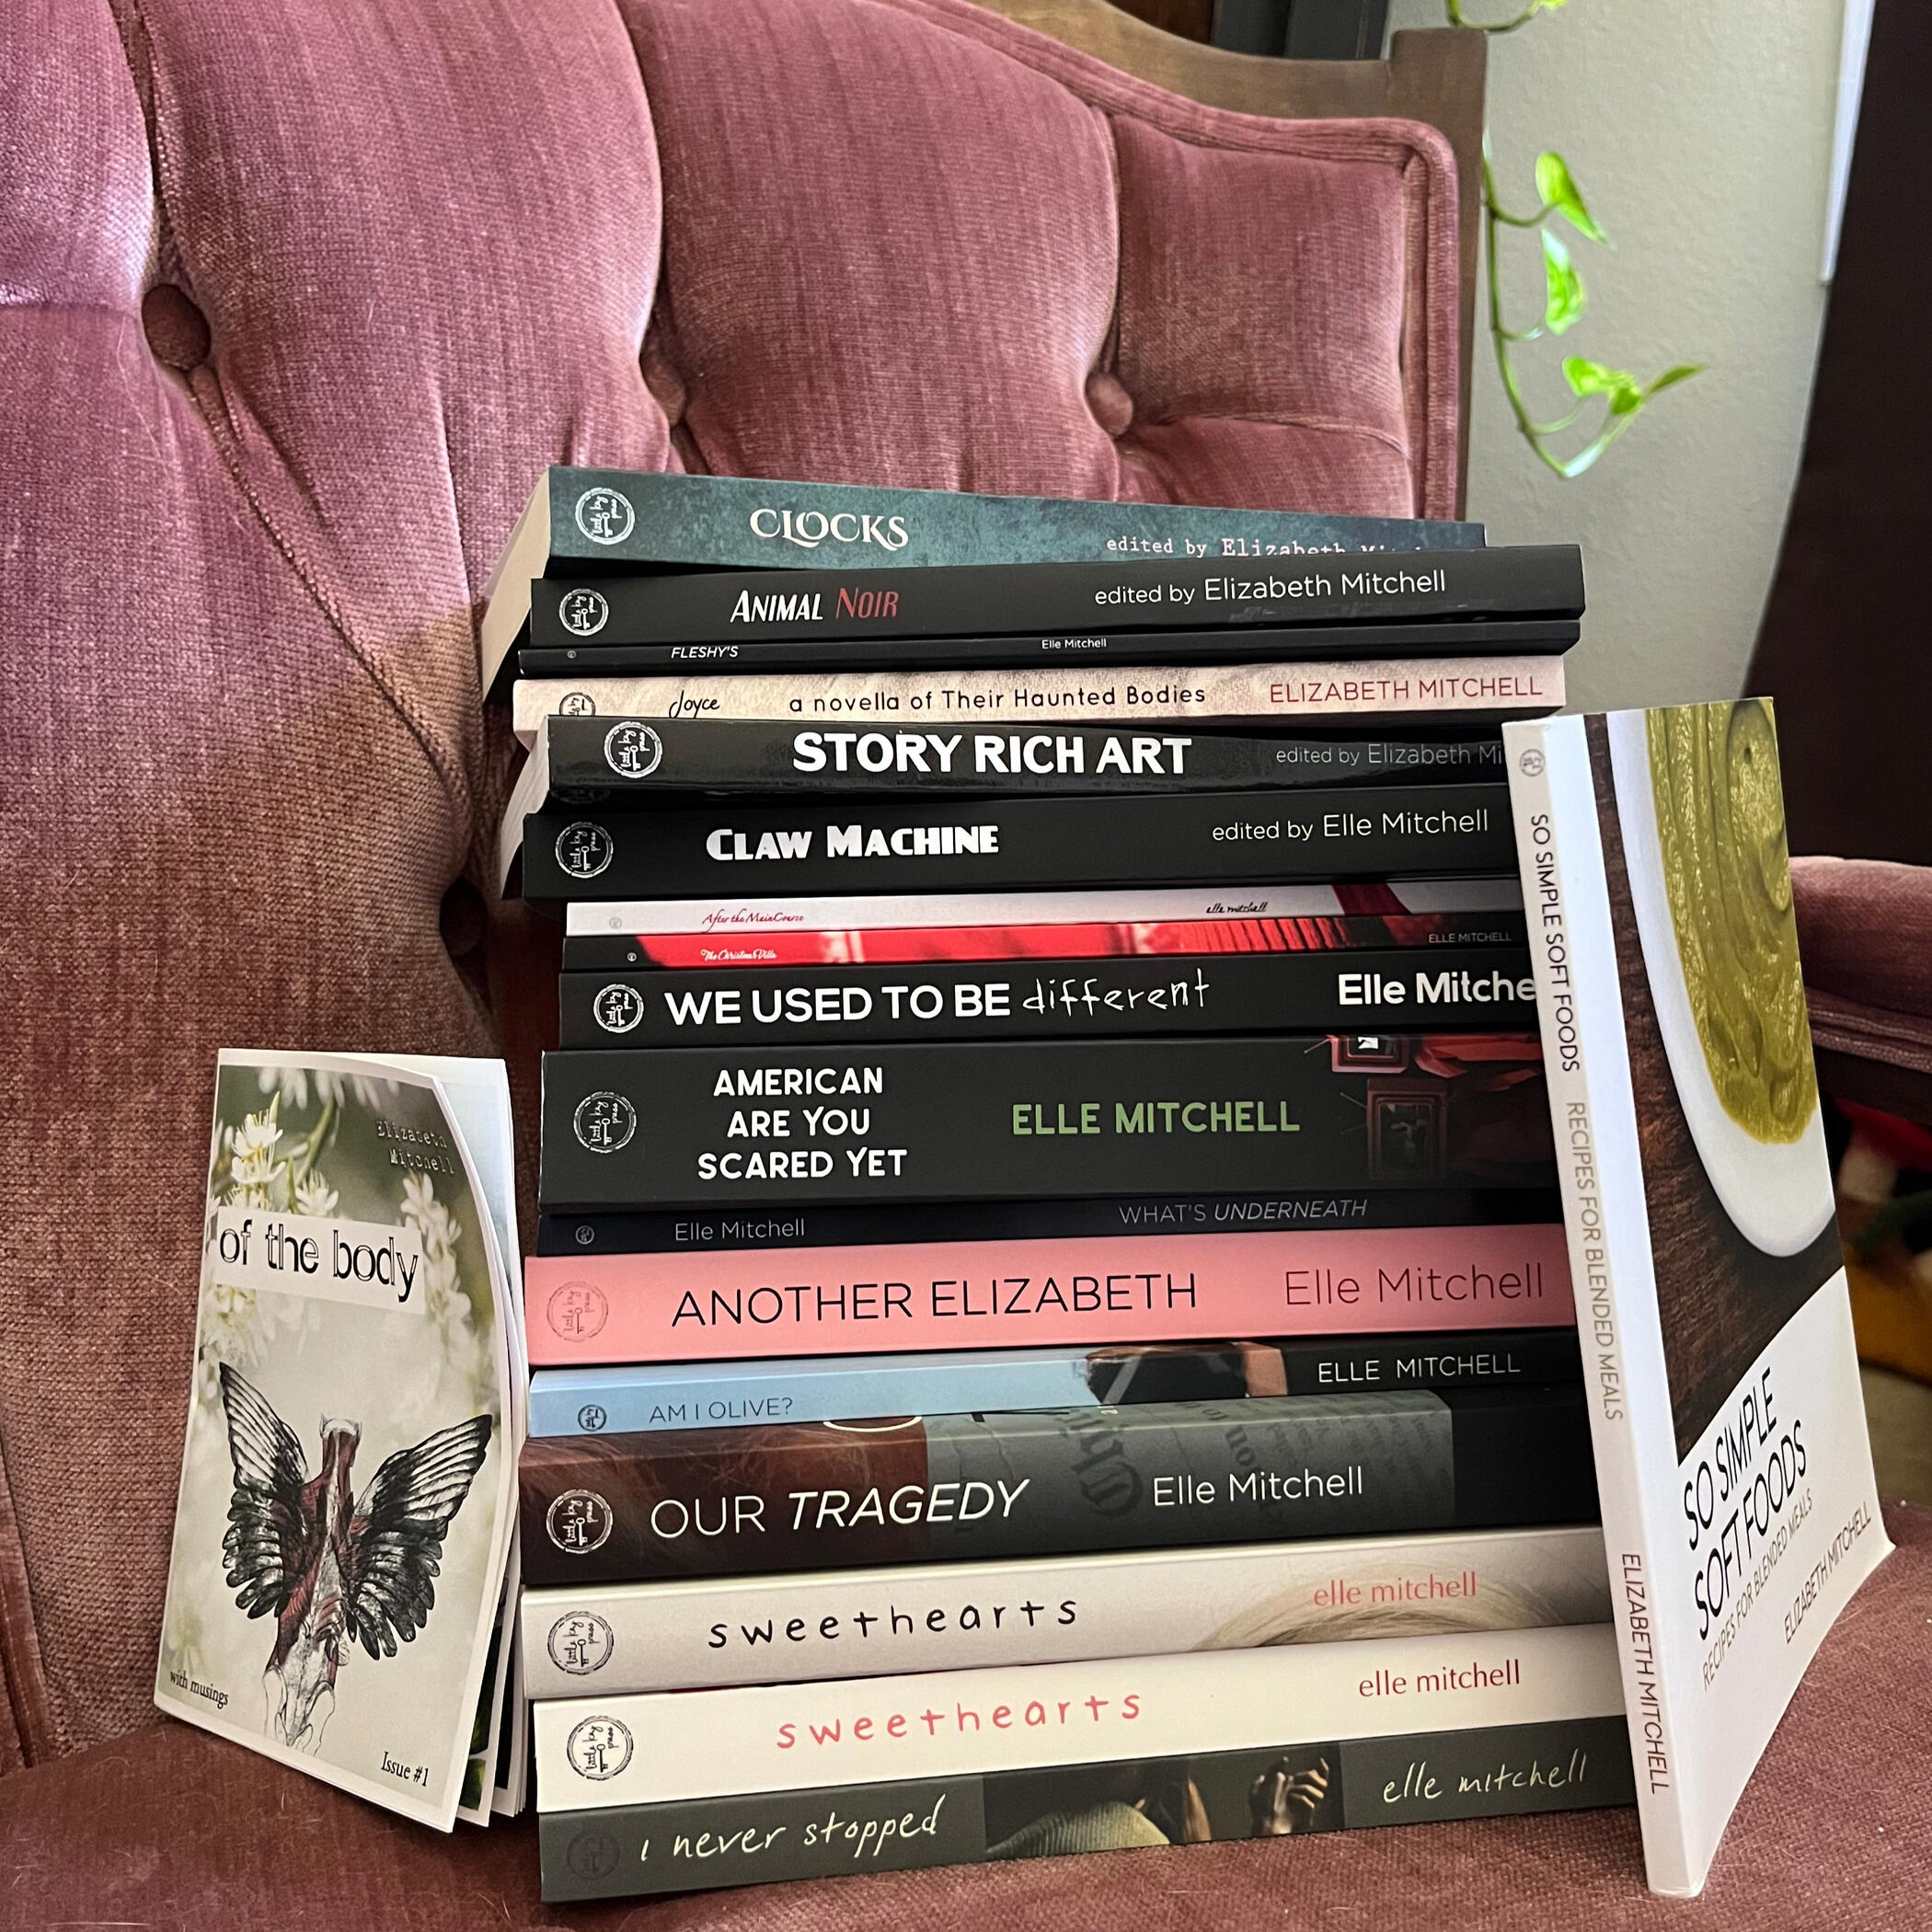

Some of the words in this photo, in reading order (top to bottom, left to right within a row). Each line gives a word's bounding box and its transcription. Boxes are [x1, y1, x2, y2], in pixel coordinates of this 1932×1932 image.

[749, 509, 909, 552] CLOCKS
[1106, 537, 1174, 554] edited
[1185, 539, 1207, 558] by
[1095, 585, 1163, 606] edited
[1169, 584, 1195, 605] by
[1204, 574, 1331, 602] Elizabeth
[1340, 569, 1446, 596] Mitchell
[672, 646, 739, 659] FLESHY'S
[1041, 638, 1062, 650] Elle
[1064, 638, 1107, 648] Mitchell
[670, 690, 720, 719] Joyce
[789, 699, 802, 712] a
[813, 692, 899, 712] novella
[910, 692, 933, 710] of
[942, 690, 1005, 710] Their
[1014, 686, 1115, 708] Haunted
[1127, 685, 1206, 705] Bodies
[1270, 680, 1409, 704] ELIZABETH
[1419, 676, 1544, 699] MITCHELL
[793, 732, 965, 773] STORY
[974, 736, 1085, 775] RICH
[1096, 738, 1191, 774] ART
[1275, 746, 1332, 765] edited
[1338, 747, 1360, 767] by
[1369, 743, 1470, 765] Elizabeth
[1213, 822, 1280, 842] edited
[1286, 821, 1314, 841] by
[1323, 814, 1372, 837] Elle
[1382, 810, 1489, 835] Mitchell
[1531, 813, 1550, 845] SO
[1206, 903, 1225, 914] elle
[1227, 902, 1269, 913] mitchell
[1535, 851, 1561, 926] SIMPLE
[1428, 932, 1455, 943] ELLE
[1458, 931, 1512, 942] MITCHELL
[1546, 933, 1570, 986] SOFT
[664, 991, 742, 1026] WE
[752, 987, 873, 1023] USED
[881, 986, 944, 1019] TO
[954, 983, 1010, 1018] BE
[1022, 969, 1210, 1017] different
[1339, 973, 1406, 1006] Elle
[1417, 971, 1538, 1004] Mitche
[1553, 994, 1580, 1072] FOODS
[713, 1066, 884, 1098] AMERICAN
[727, 1110, 790, 1139] ARE
[801, 1109, 871, 1136] YOU
[1013, 1104, 1100, 1135] ELLE
[1115, 1100, 1301, 1133] MITCHELL
[697, 1150, 834, 1180] SCARED
[846, 1147, 908, 1178] YET
[1567, 1102, 1594, 1190] RECIPES
[674, 1222, 714, 1242] Elle
[721, 1218, 805, 1239] Mitchell
[1119, 1204, 1207, 1225] WHAT'S
[1214, 1200, 1367, 1222] UNDERNEATH
[1579, 1195, 1601, 1242] FOR
[220, 1220, 252, 1265] of
[266, 1224, 319, 1274] the
[333, 1230, 419, 1303] body
[672, 1282, 913, 1328] ANOTHER
[931, 1273, 1196, 1318] ELIZABETH
[1286, 1270, 1360, 1305] Elle
[1378, 1262, 1544, 1302] Mitchell
[1585, 1249, 1614, 1347] BLENDED
[1318, 1360, 1380, 1384] ELLE
[1396, 1354, 1520, 1378] MITCHELL
[1598, 1354, 1623, 1420] MEALS
[649, 1406, 686, 1423] AM
[694, 1405, 701, 1420] I
[708, 1397, 793, 1420] OLIVE?
[1685, 1461, 1713, 1550] SO
[1716, 1367, 1777, 1501] SIMPLE
[1153, 1477, 1215, 1507] Elle
[1229, 1466, 1363, 1501] Mitchell
[650, 1496, 765, 1539] OUR
[788, 1478, 1030, 1531] TRAGEDY
[1695, 1509, 1742, 1639] SOFT
[1743, 1420, 1806, 1558] FOODS
[1313, 1579, 1362, 1607] elle
[1371, 1571, 1476, 1603] mitchell
[1703, 1613, 1736, 1691] RECIPES
[1737, 1582, 1753, 1628] FOR
[1754, 1525, 1788, 1597] BLENDED
[1788, 1488, 1812, 1542] MEALS
[1784, 1556, 1828, 1644] ELIZABETH
[1827, 1501, 1871, 1573] MITCHELL
[707, 1599, 1077, 1650] sweethearts
[169, 1670, 188, 1691] with
[190, 1675, 228, 1708] musings
[1359, 1670, 1407, 1696] elle
[1417, 1660, 1520, 1693] mitchell
[1622, 1553, 1654, 1676] ELIZABETH
[1638, 1681, 1669, 1794] MITCHELL
[776, 1694, 1141, 1749] sweethearts
[381, 1752, 410, 1780] Issue
[414, 1766, 429, 1787] #1
[1384, 1761, 1442, 1803] elle
[1459, 1748, 1587, 1793] mitchell
[673, 1826, 786, 1859] never
[803, 1794, 946, 1857] stopped
